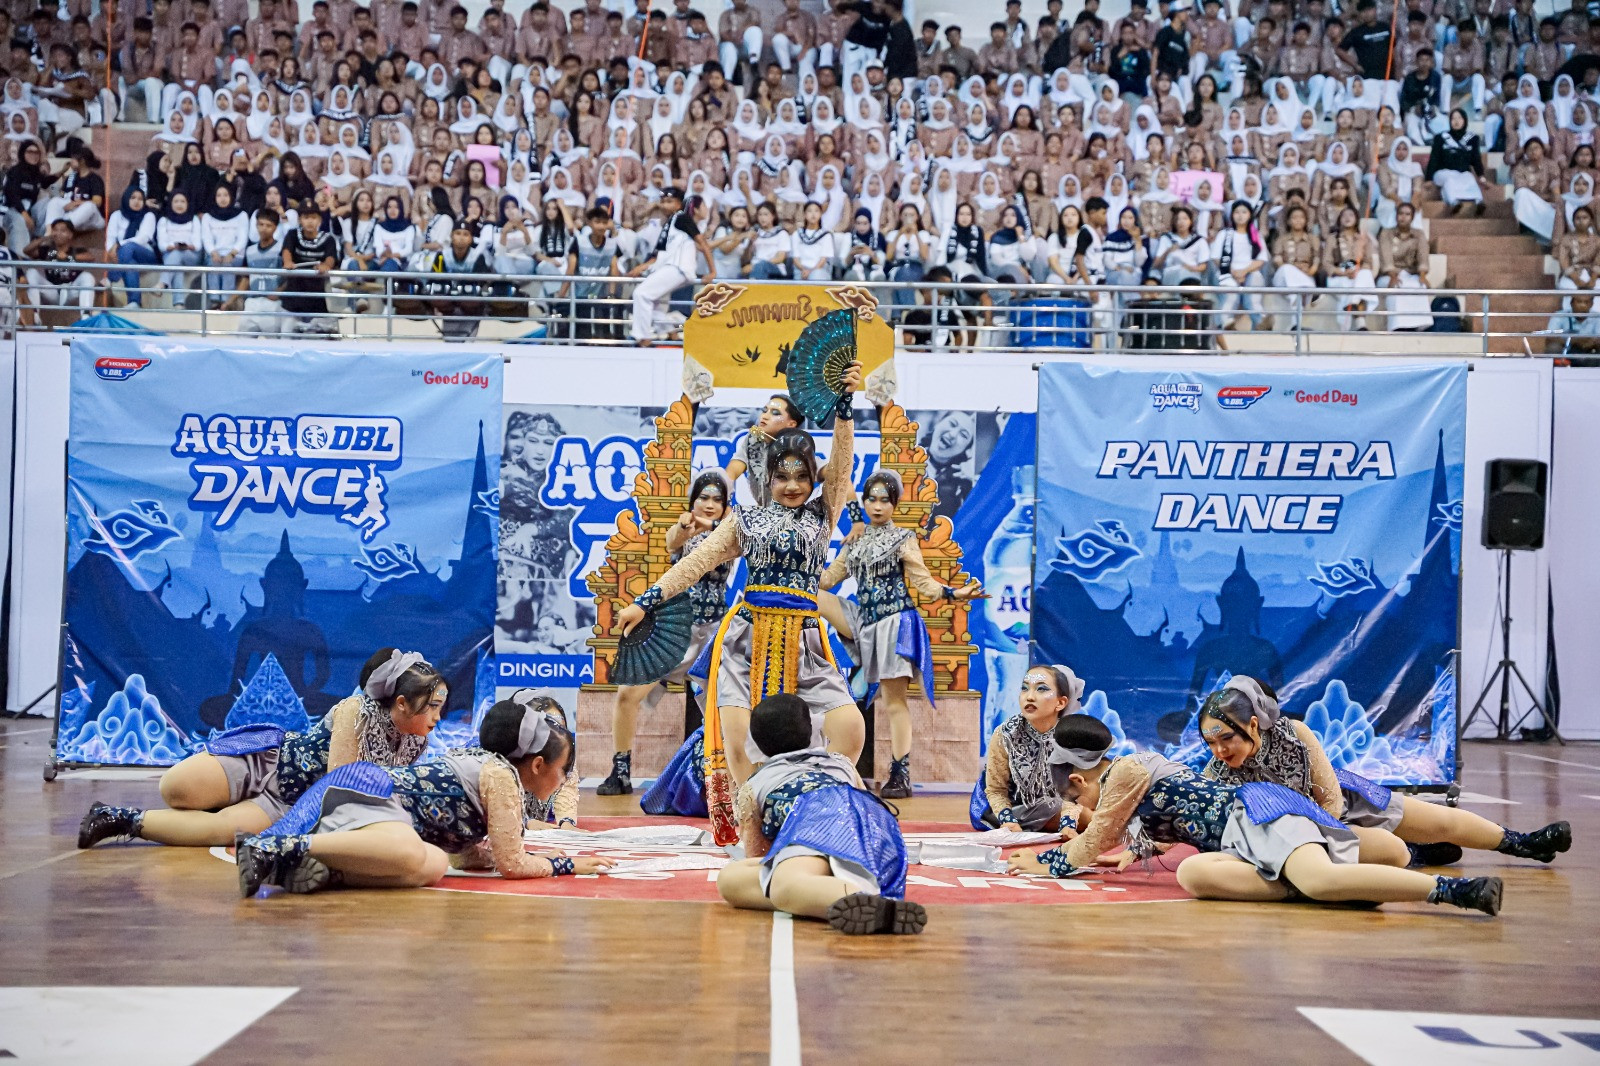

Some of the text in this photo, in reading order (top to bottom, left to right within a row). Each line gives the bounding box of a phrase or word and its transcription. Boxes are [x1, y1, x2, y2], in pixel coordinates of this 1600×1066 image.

[108, 368, 123, 376] DBL
[423, 370, 459, 385] Good
[462, 371, 489, 389] Day
[1150, 384, 1177, 396] AQUA
[1295, 390, 1329, 403] Good
[1331, 390, 1358, 406] Day
[1153, 395, 1195, 411] DANCE
[175, 416, 394, 462] AQUA DBL
[1096, 440, 1397, 480] PANTHERA
[192, 464, 366, 526] DANCE
[1152, 493, 1344, 533] DANCE
[499, 662, 575, 677] DINGIN
